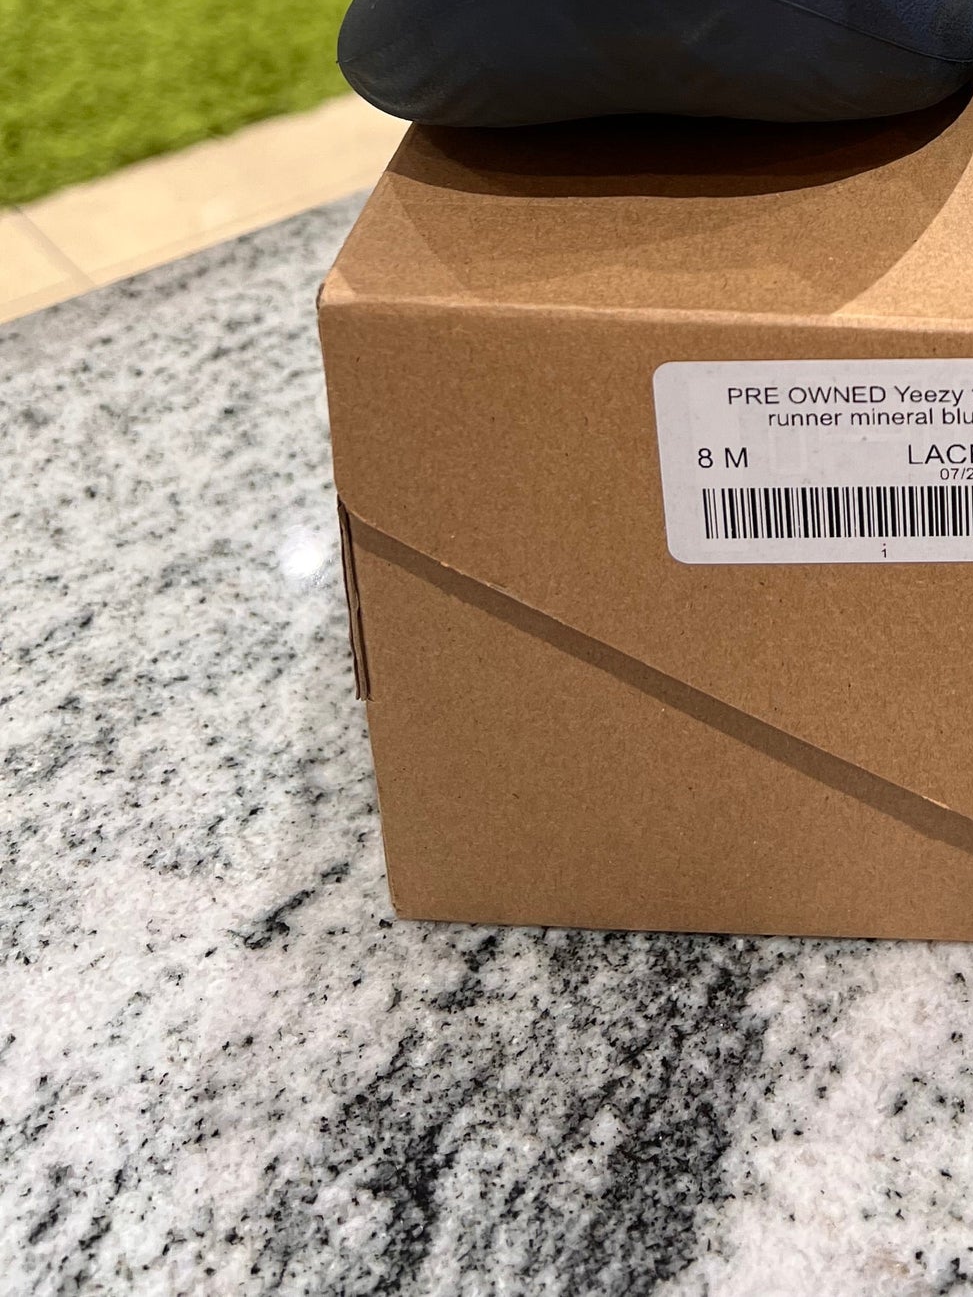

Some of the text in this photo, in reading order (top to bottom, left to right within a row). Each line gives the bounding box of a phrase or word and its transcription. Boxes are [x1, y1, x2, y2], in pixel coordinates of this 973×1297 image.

[727, 386, 781, 406] PRE
[787, 385, 887, 405] OWNED
[893, 385, 965, 407] Yeezy
[768, 412, 843, 427] runner
[850, 407, 934, 426] mineral
[697, 446, 749, 469] 8 M
